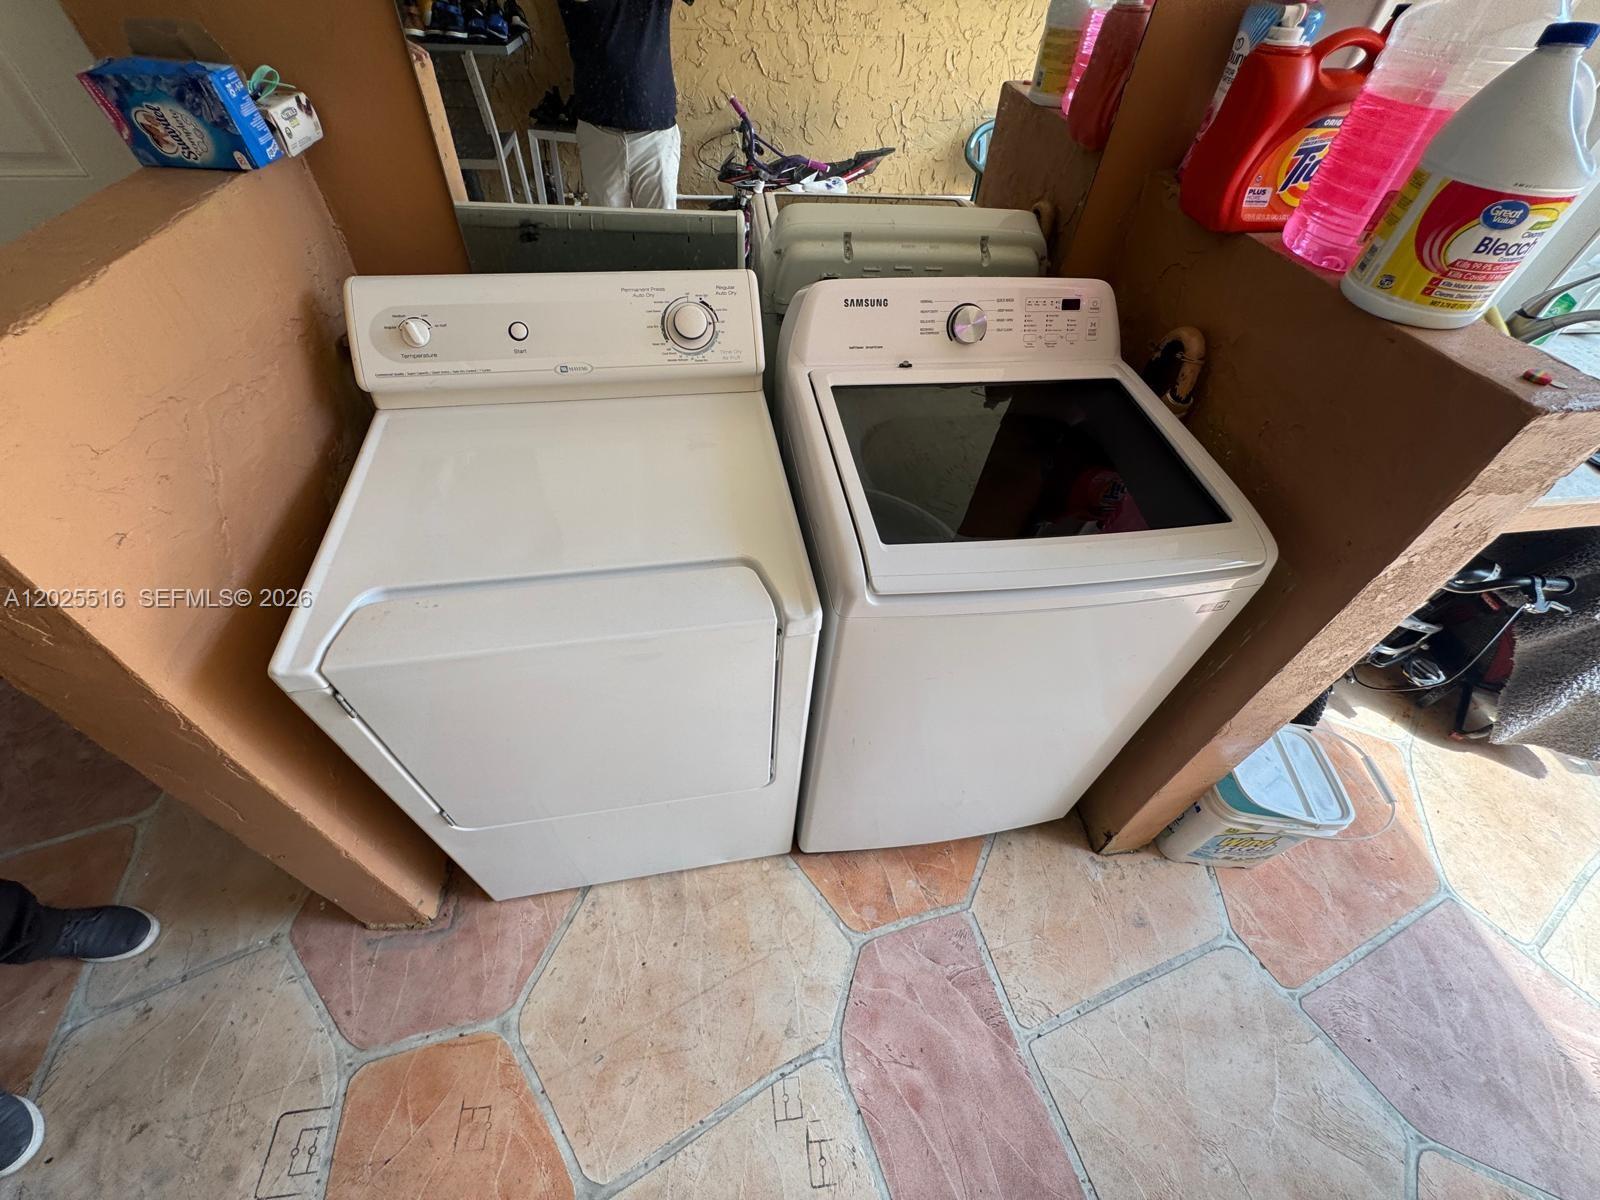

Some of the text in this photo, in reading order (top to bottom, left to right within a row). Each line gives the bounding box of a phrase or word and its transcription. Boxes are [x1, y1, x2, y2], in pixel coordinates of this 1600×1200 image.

[1324, 118, 1342, 126] ORIG
[145, 104, 199, 161] Suavitel
[1248, 188, 1267, 196] PLUS
[1490, 205, 1524, 218] Great
[1492, 215, 1517, 225] Value
[843, 298, 889, 307] SAMSUNG
